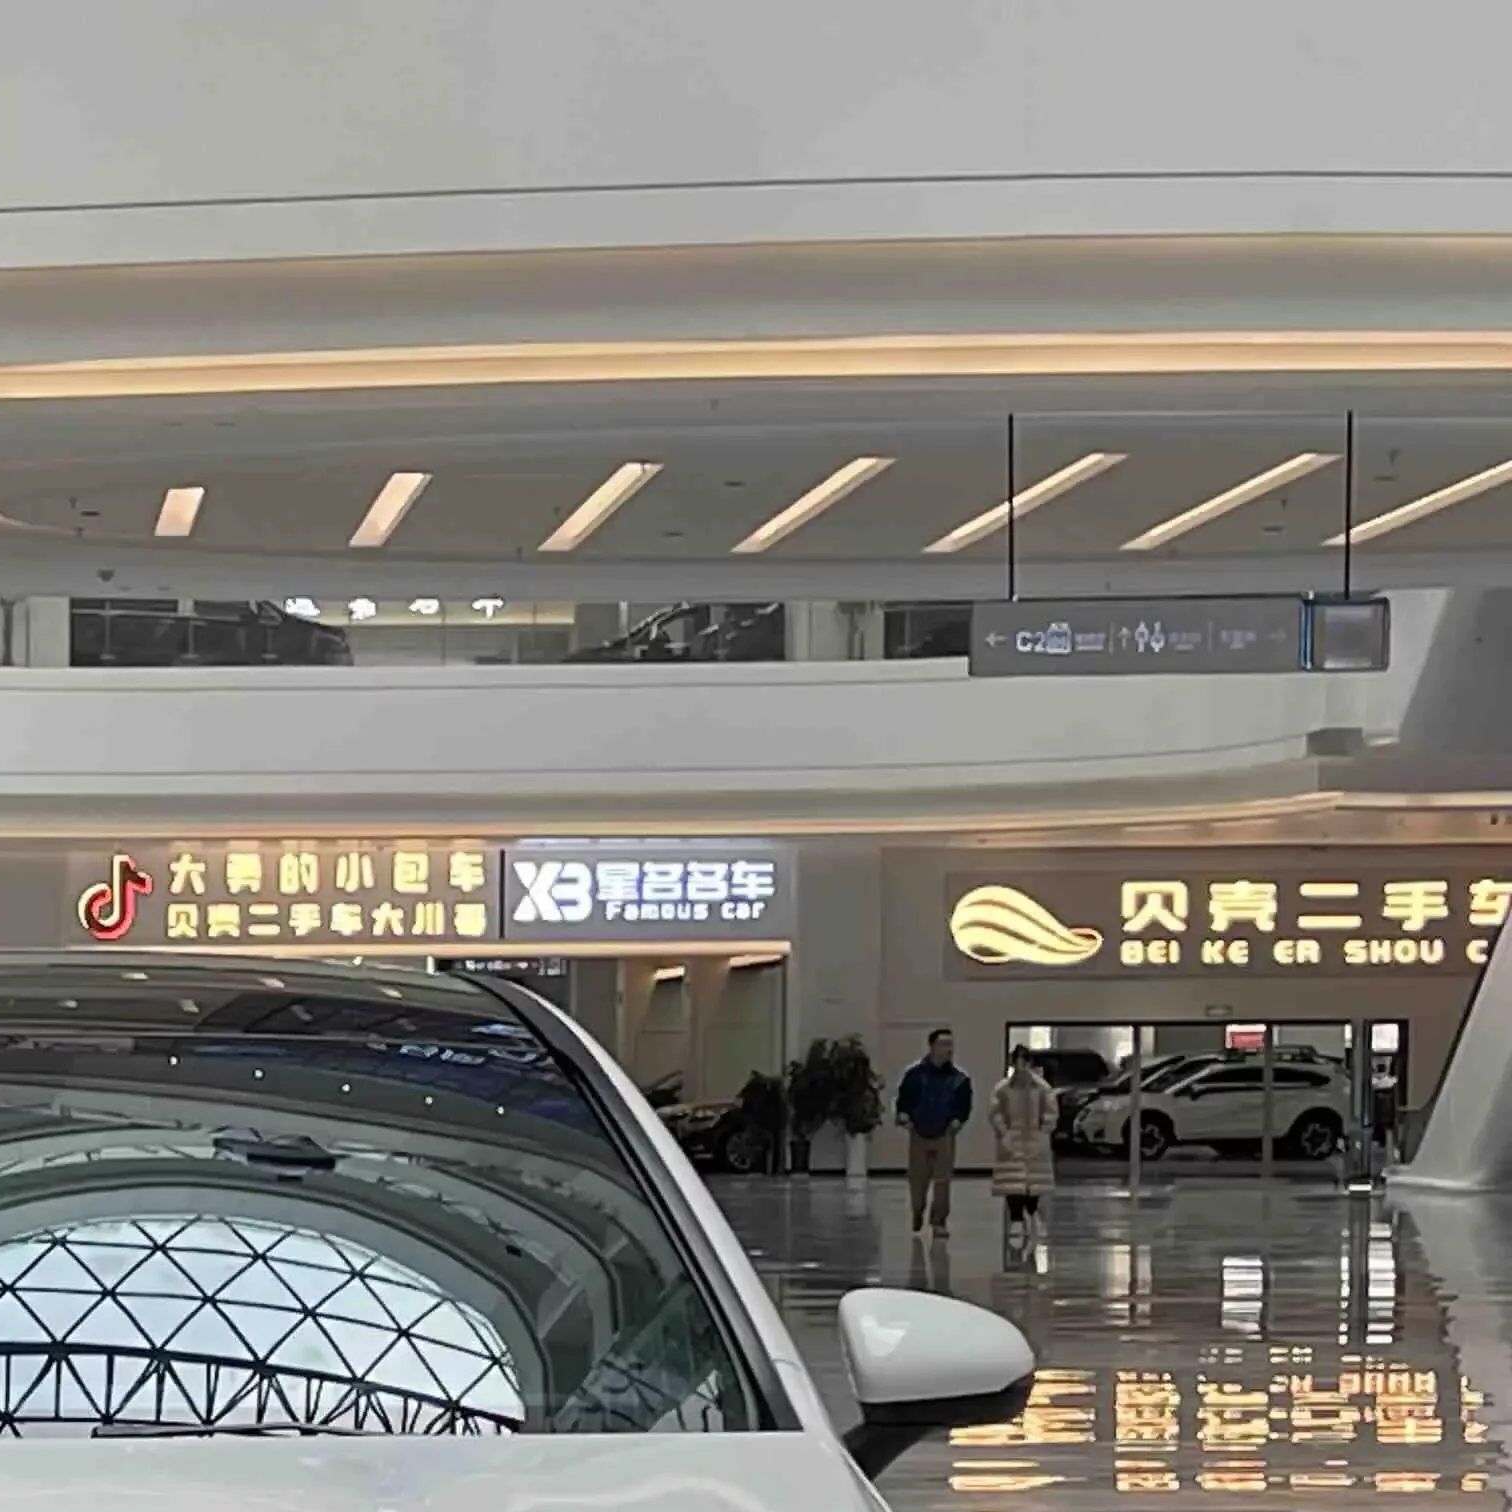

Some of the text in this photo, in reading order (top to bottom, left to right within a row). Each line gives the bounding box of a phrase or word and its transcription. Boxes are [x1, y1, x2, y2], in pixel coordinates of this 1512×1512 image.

[1120, 939, 1180, 965] BEI
[1201, 939, 1249, 965] KE
[1343, 939, 1444, 965] SHOU
